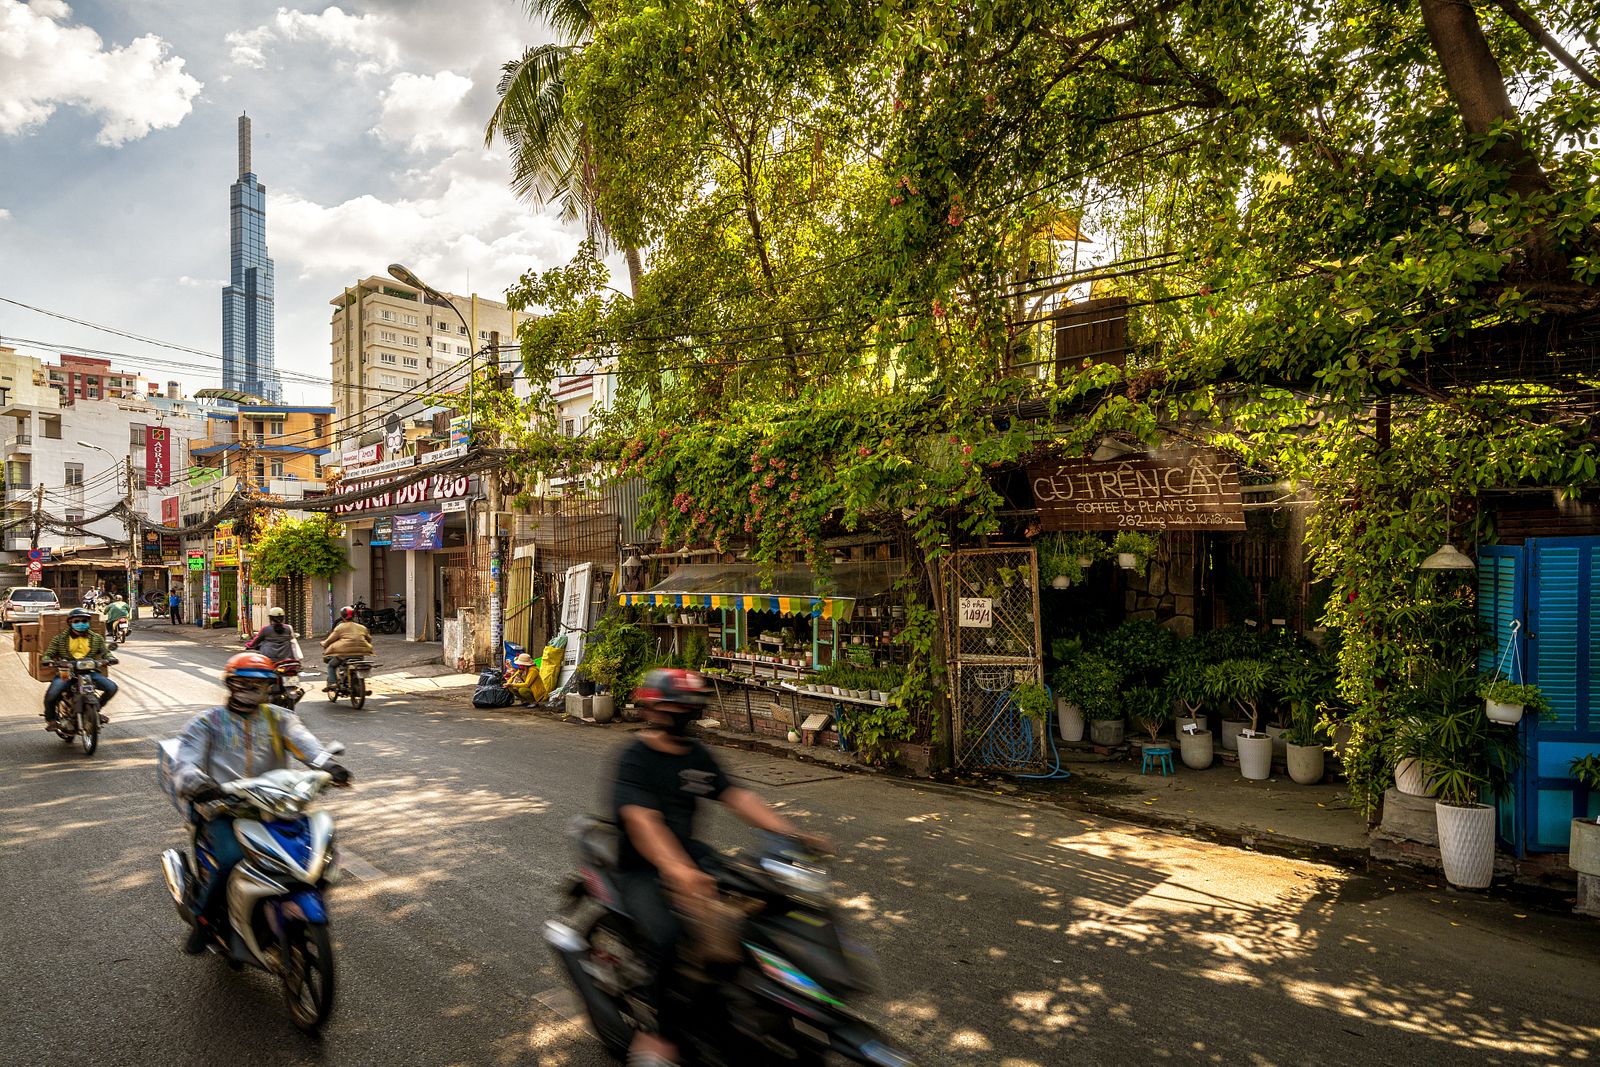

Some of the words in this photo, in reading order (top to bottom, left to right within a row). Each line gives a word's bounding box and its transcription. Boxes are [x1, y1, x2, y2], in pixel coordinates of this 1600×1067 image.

[154, 441, 163, 485] AGRIBANK
[1033, 467, 1074, 502] CÚ
[1077, 462, 1160, 498] TRÊN
[1164, 458, 1231, 495] CÂY
[1075, 502, 1120, 513] COFFEE
[1123, 500, 1136, 512] &
[1138, 498, 1197, 513] PLANTS
[1116, 514, 1145, 527] 262
[963, 609, 990, 624] 149/1
